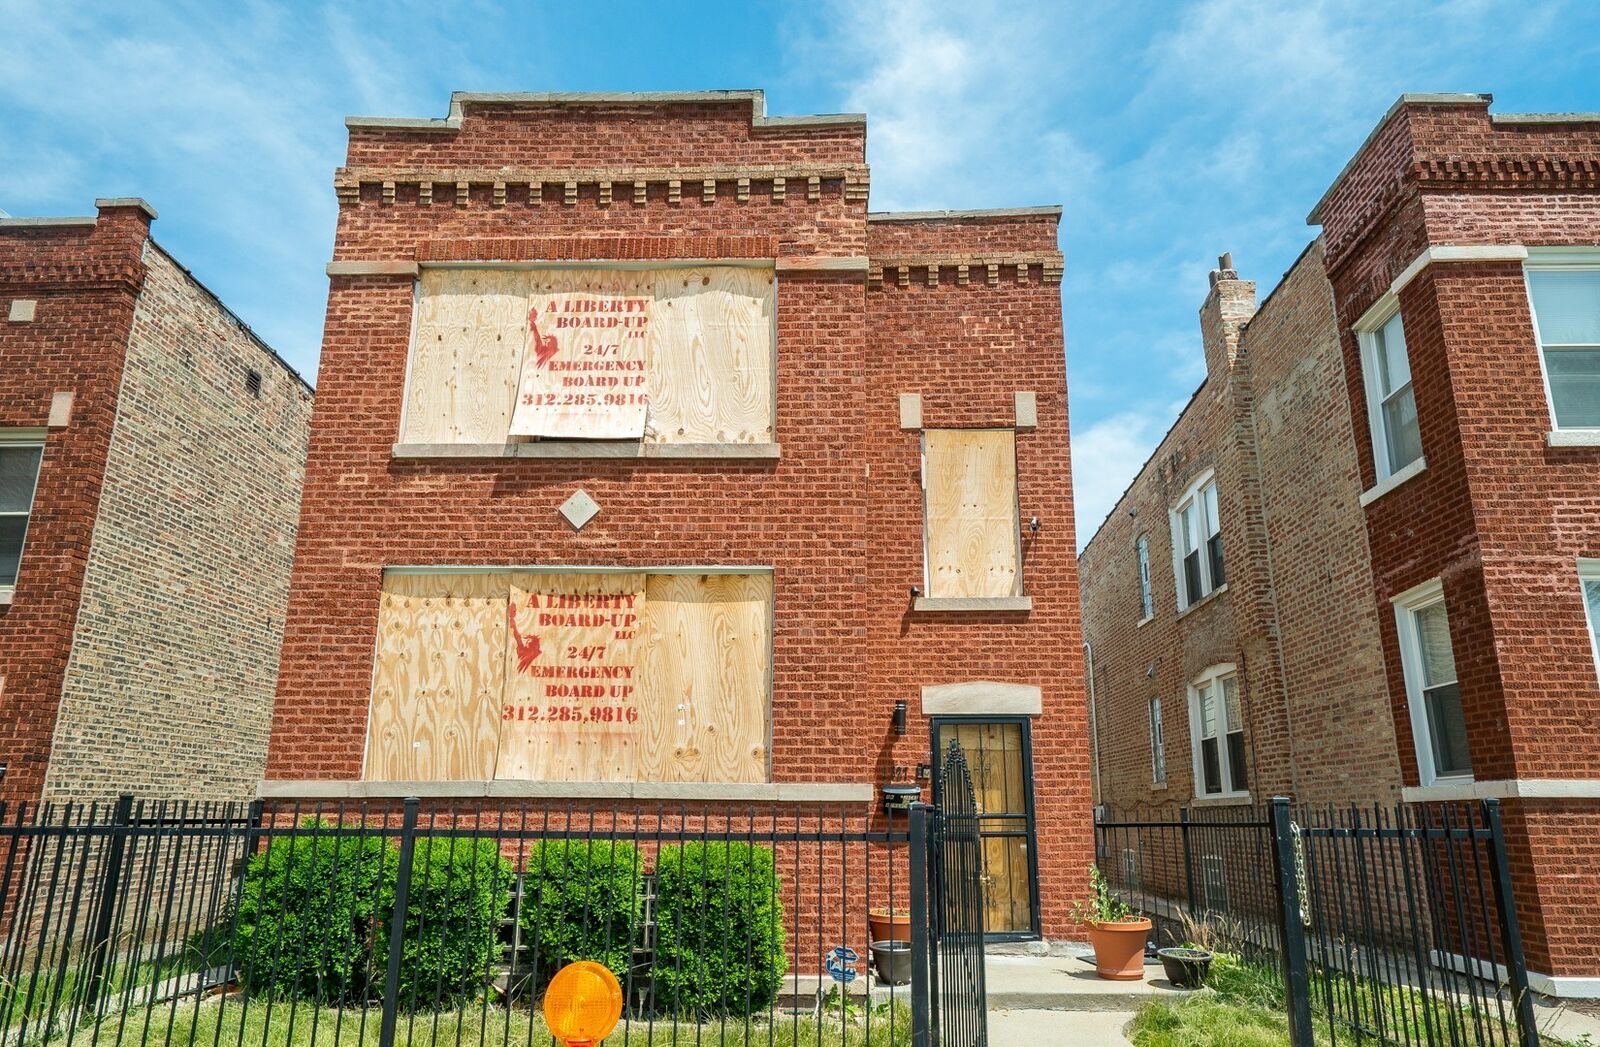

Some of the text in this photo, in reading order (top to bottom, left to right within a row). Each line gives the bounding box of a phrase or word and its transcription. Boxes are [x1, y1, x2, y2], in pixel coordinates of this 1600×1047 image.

[546, 300, 649, 313] A LIBERTY
[556, 317, 648, 329] BOARD-UP
[628, 331, 648, 339] LLC
[584, 345, 619, 357] 24/7
[549, 361, 646, 372] EMERGENCY
[562, 376, 646, 387] BOARD UP
[522, 394, 649, 406] 312.285.9816
[527, 593, 637, 609] A LIBERTY
[538, 614, 637, 627] BOARD-UP
[615, 631, 636, 640] LLC
[567, 646, 606, 661] 24/7
[531, 666, 634, 679] EMERGENCY
[545, 685, 634, 698] BOARD UP
[502, 705, 638, 722] 312.285.9816
